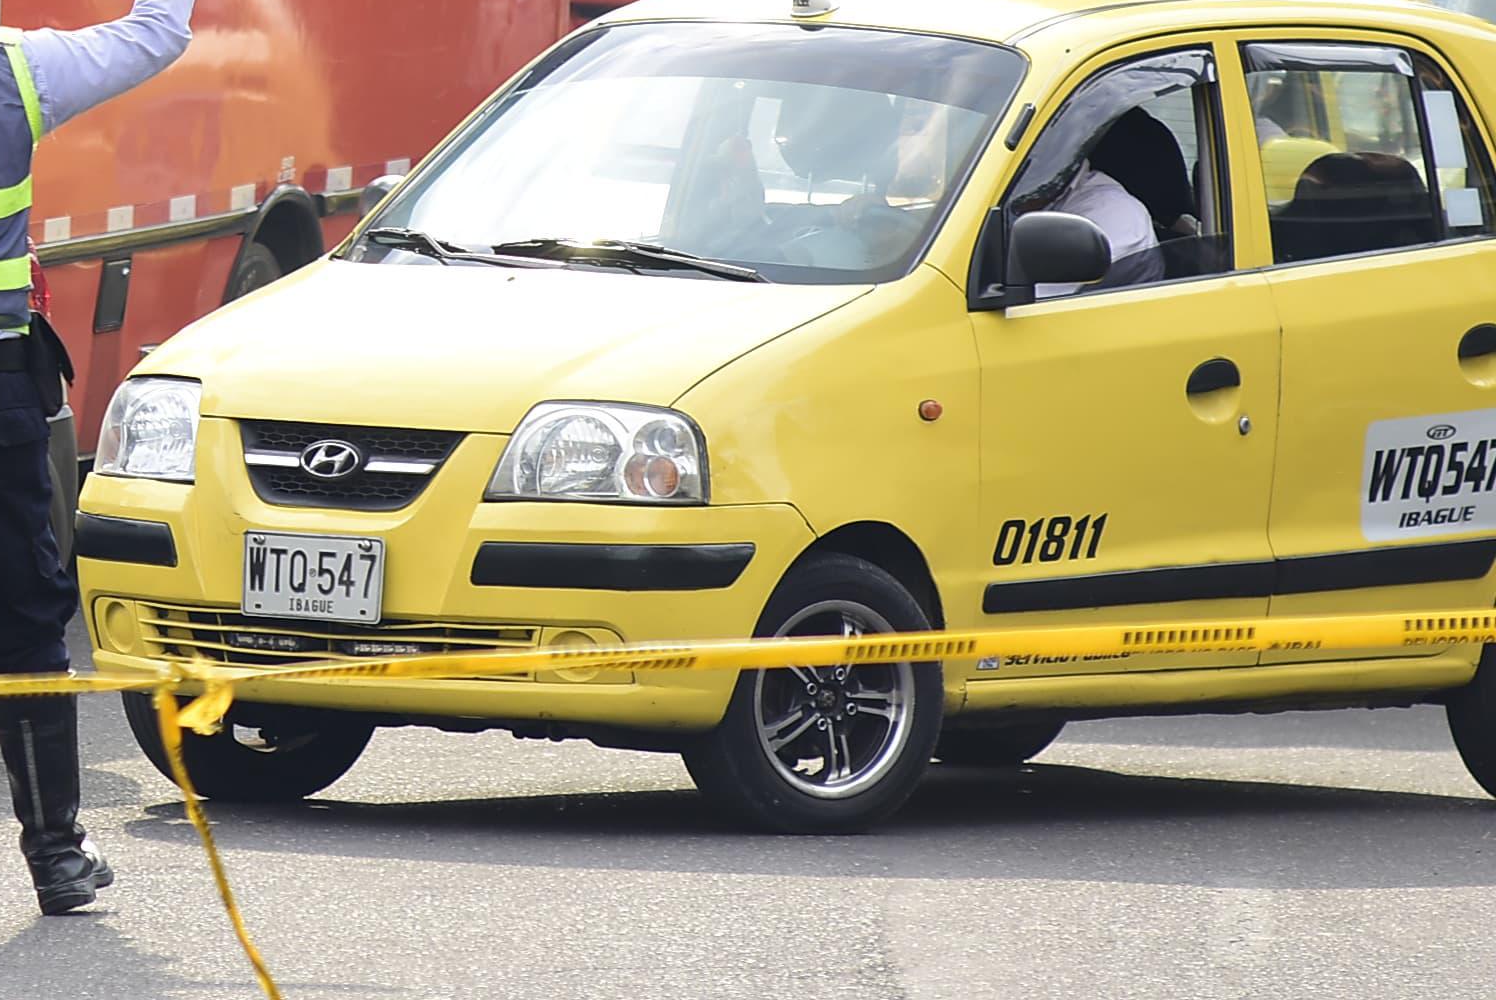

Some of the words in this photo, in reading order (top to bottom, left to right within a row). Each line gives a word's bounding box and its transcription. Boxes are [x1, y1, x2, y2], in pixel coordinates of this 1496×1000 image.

[1398, 505, 1476, 528] IBAGUE
[992, 512, 1108, 567] 01811
[289, 597, 334, 613] IBAGUE
